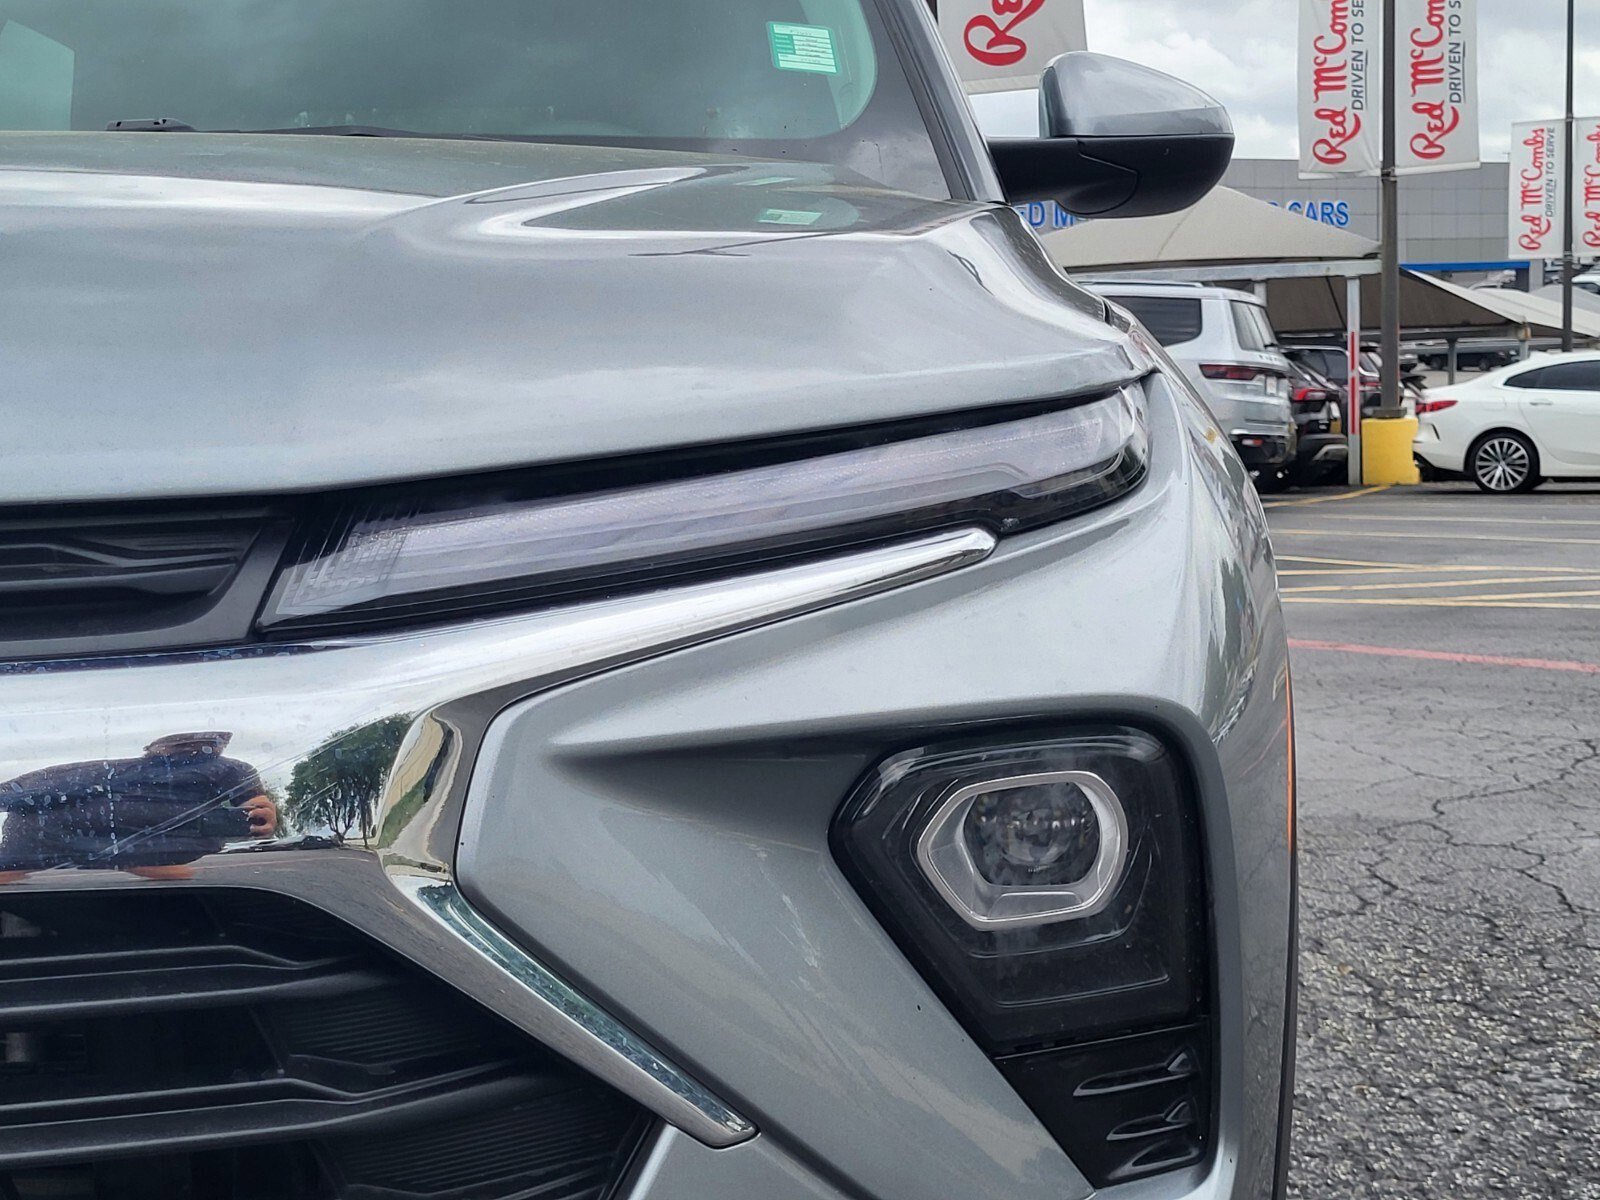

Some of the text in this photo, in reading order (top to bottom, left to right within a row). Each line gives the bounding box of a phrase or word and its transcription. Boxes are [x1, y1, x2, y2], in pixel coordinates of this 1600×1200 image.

[963, 0, 1045, 66] Re
[1351, 22, 1364, 45] TO
[1448, 14, 1461, 37] TO
[1312, 0, 1361, 165] Red McCom
[1351, 50, 1364, 111] DRIVEN
[1409, 0, 1460, 160] Red McCom
[1448, 42, 1462, 104] DRIVEN
[1518, 128, 1551, 251] Red McCombs
[1545, 127, 1555, 217] DRIVEN TO SERVE
